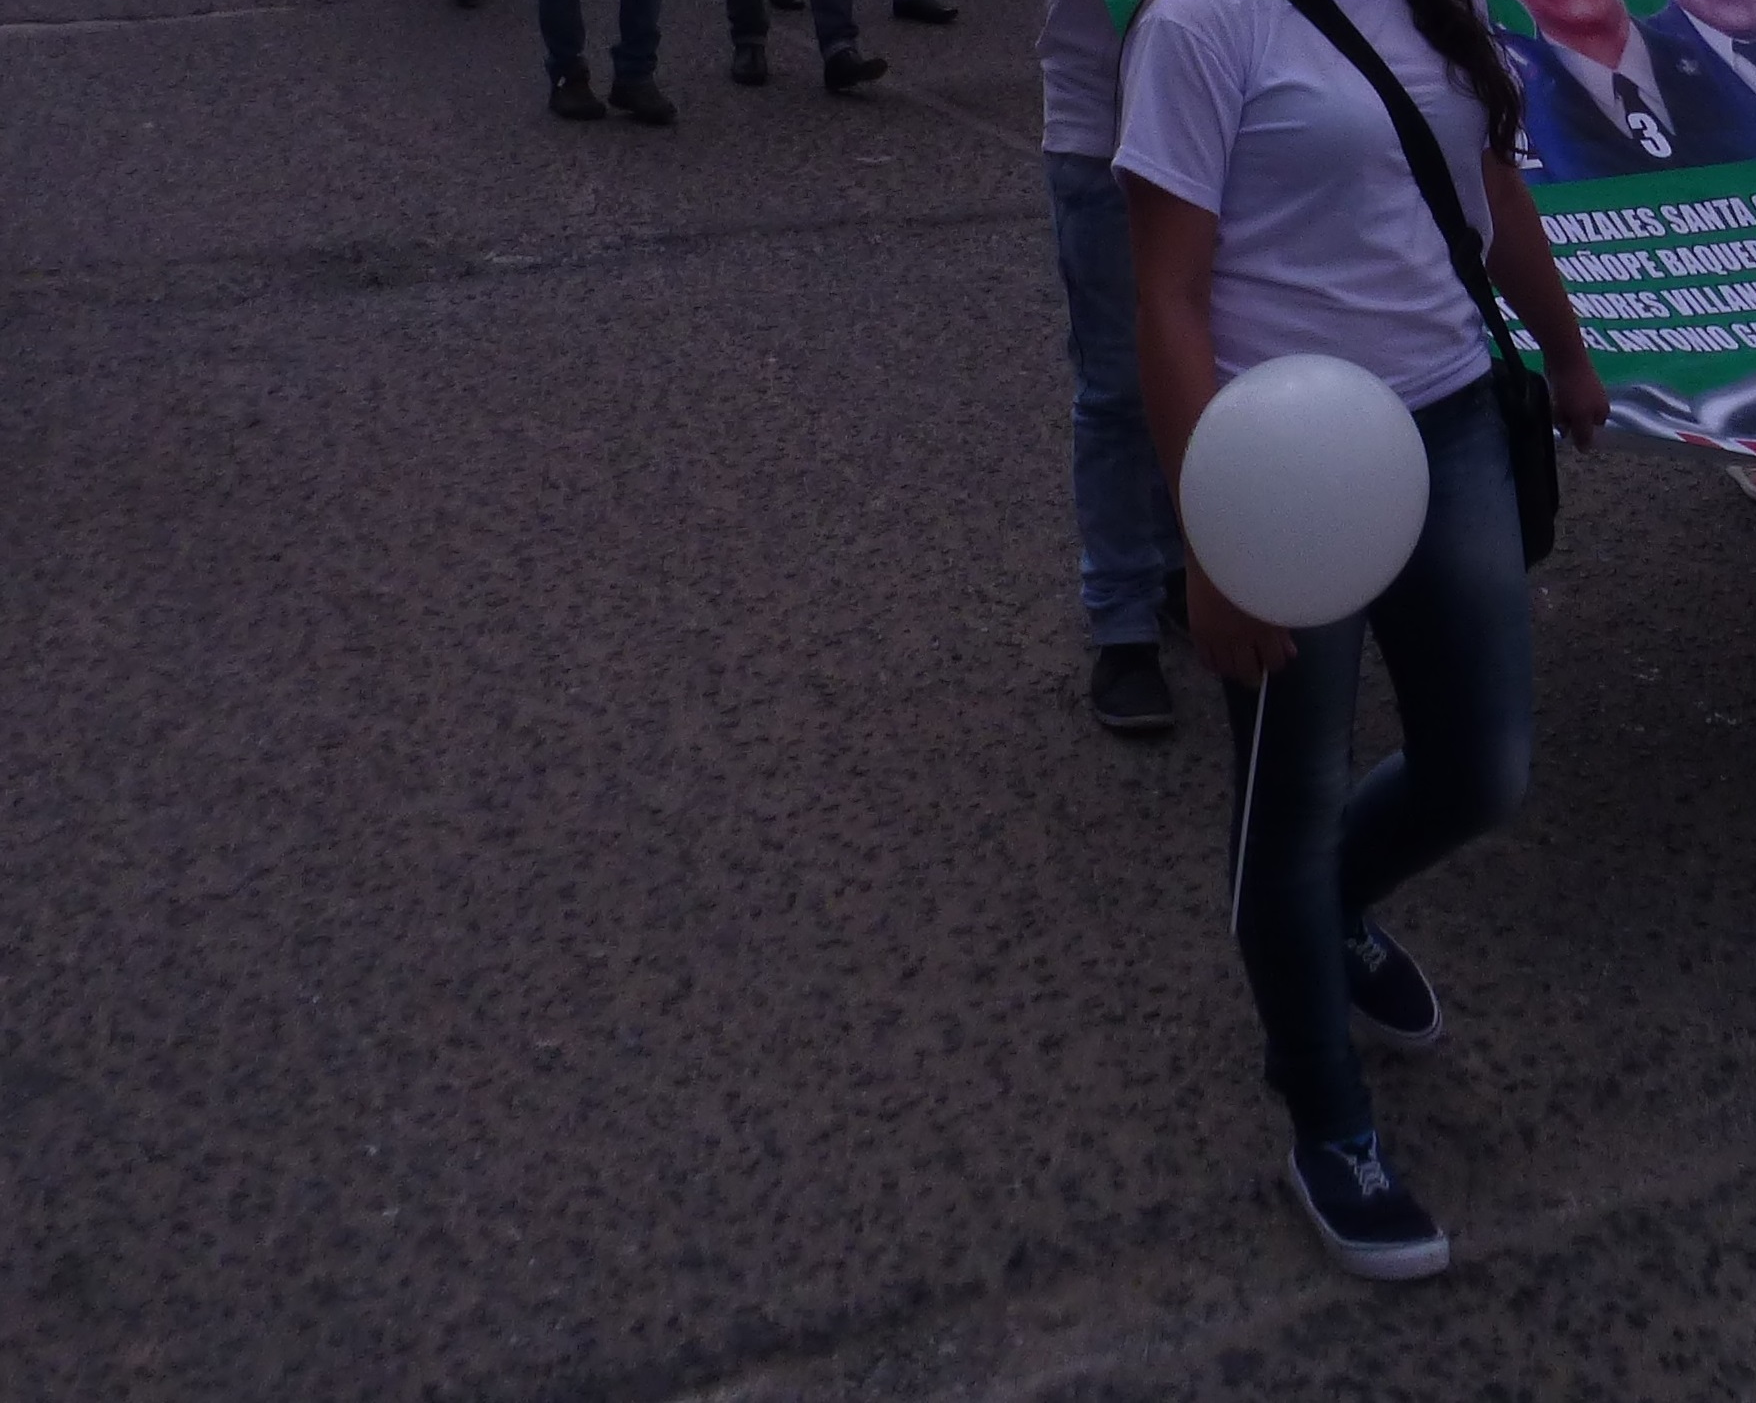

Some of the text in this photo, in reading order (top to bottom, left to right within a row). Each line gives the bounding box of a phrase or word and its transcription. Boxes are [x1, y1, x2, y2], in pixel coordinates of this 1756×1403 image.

[1627, 111, 1673, 159] 3
[1540, 206, 1667, 245] ONZALES
[1567, 291, 1671, 320] NDRES
[1605, 324, 1740, 353] ANTONIO
